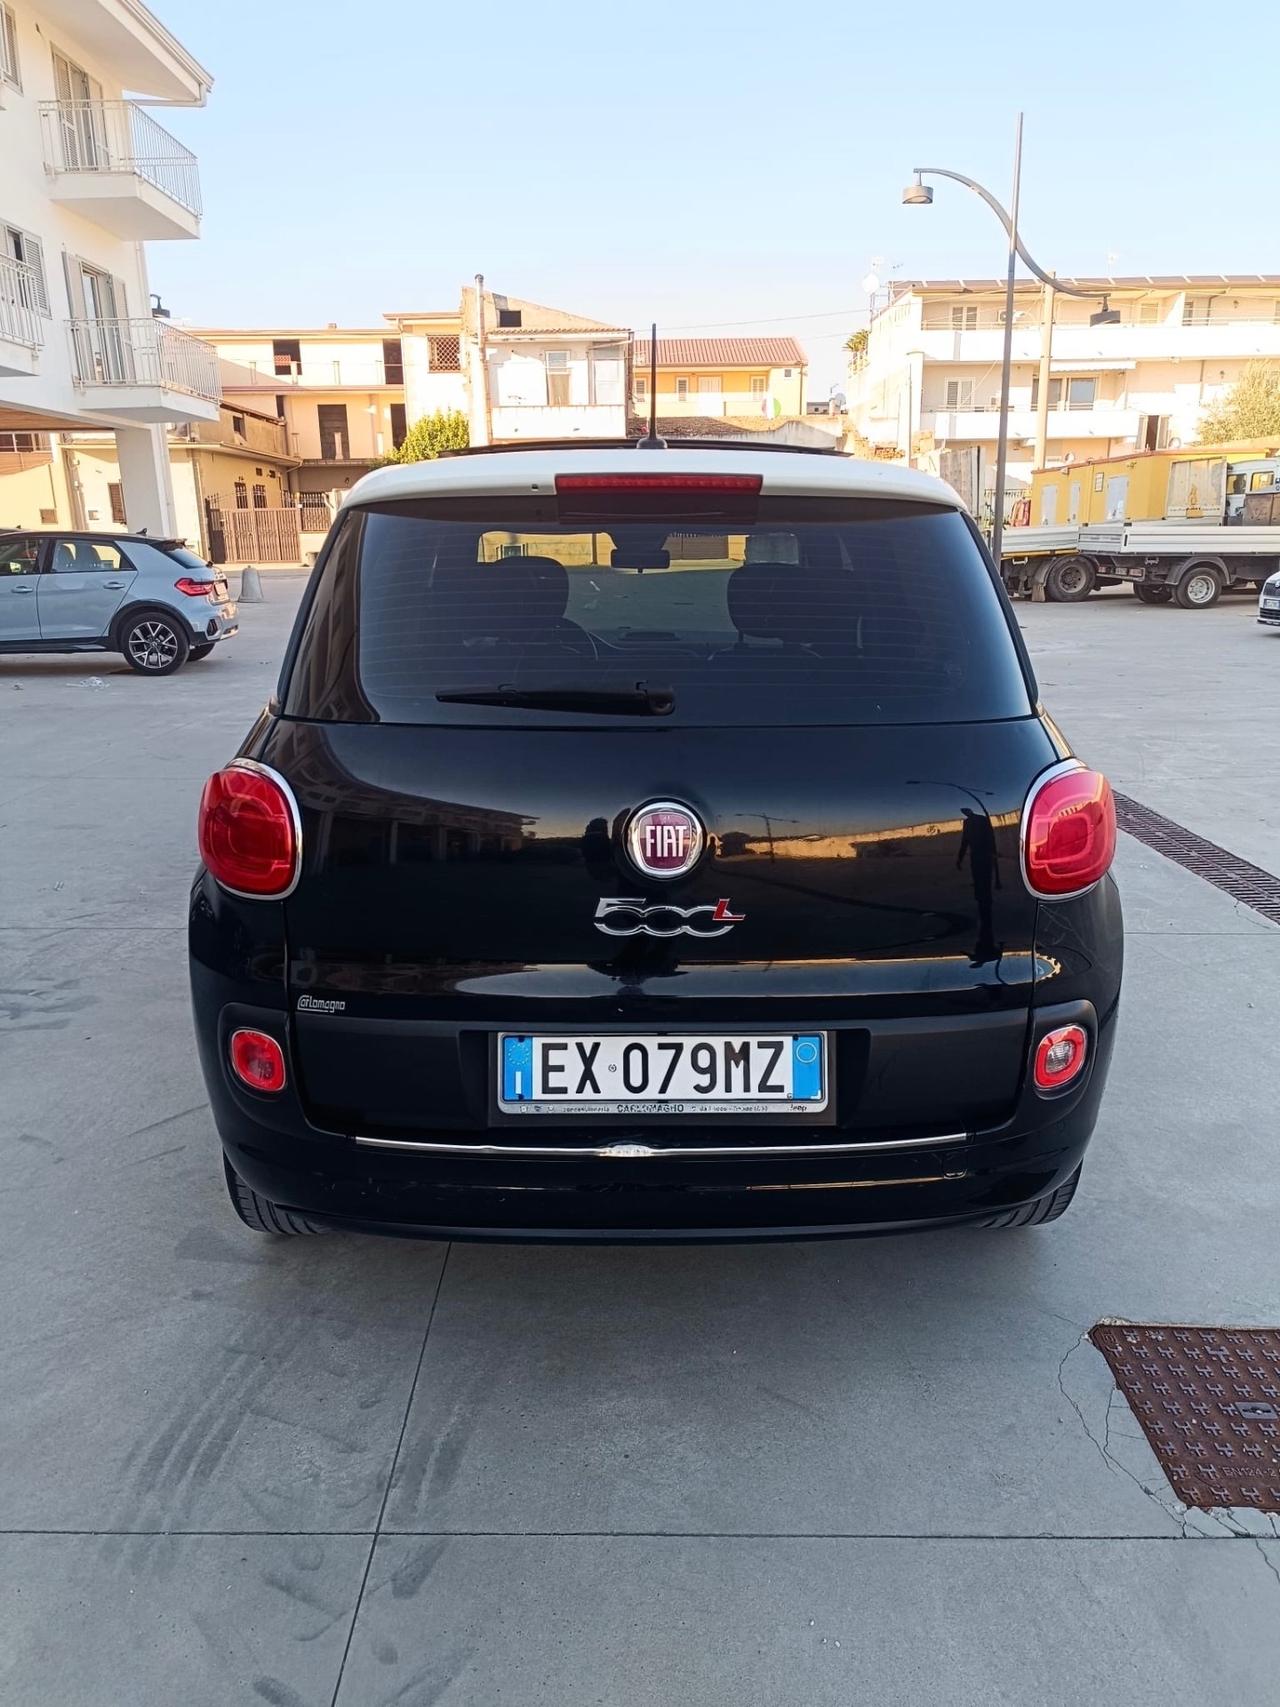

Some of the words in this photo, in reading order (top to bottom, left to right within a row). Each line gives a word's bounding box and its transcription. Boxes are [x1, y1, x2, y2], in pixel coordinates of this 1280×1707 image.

[645, 825, 688, 858] FIAT
[541, 1042, 601, 1095] EX
[623, 1041, 785, 1095] 079MZ
